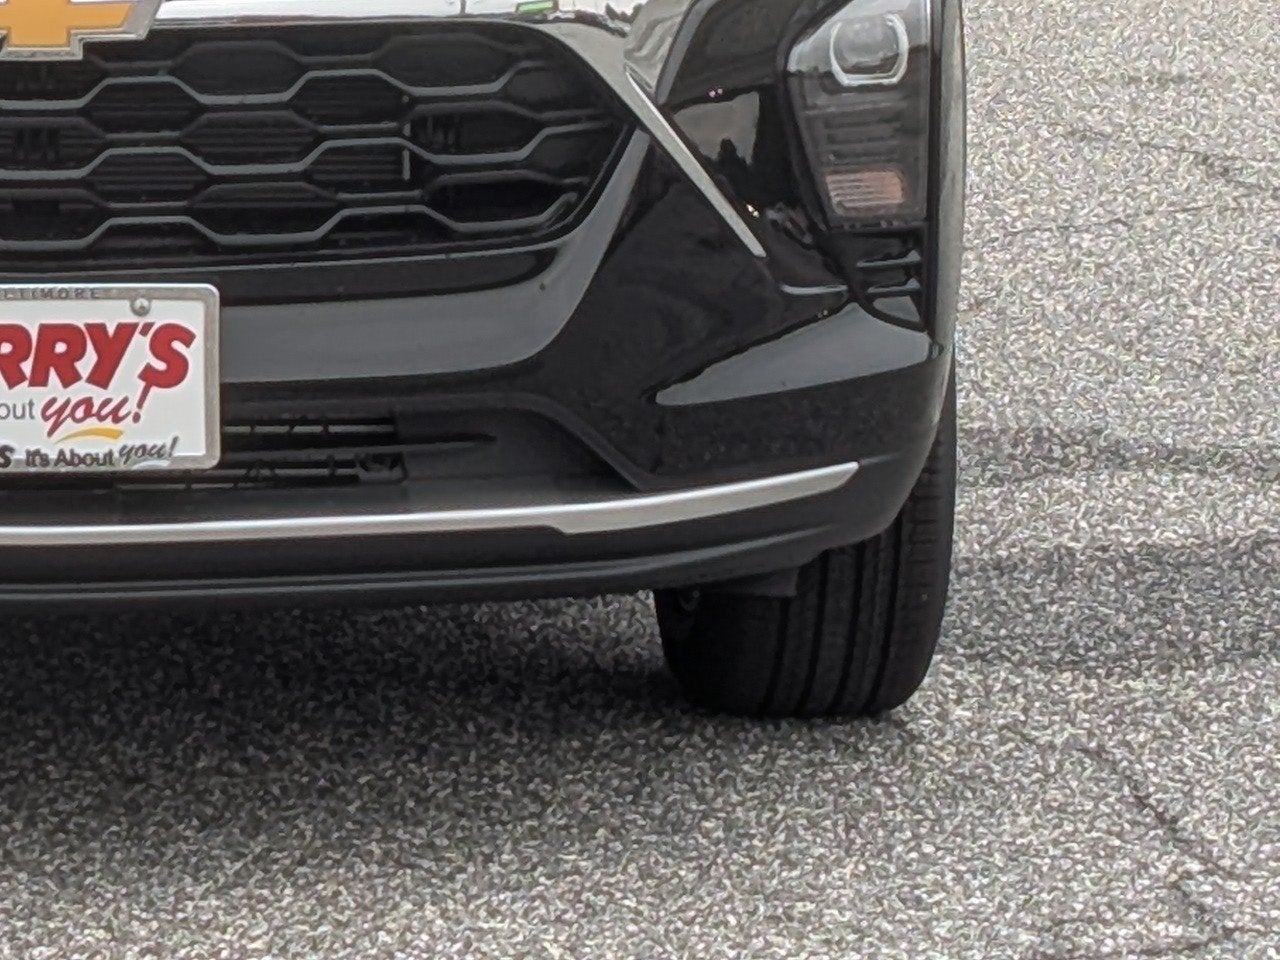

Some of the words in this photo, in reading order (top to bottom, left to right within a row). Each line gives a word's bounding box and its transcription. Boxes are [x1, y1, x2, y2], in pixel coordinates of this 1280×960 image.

[40, 382, 152, 438] you!
[24, 447, 51, 467] It's
[53, 445, 115, 467] About
[118, 436, 179, 465] you!
